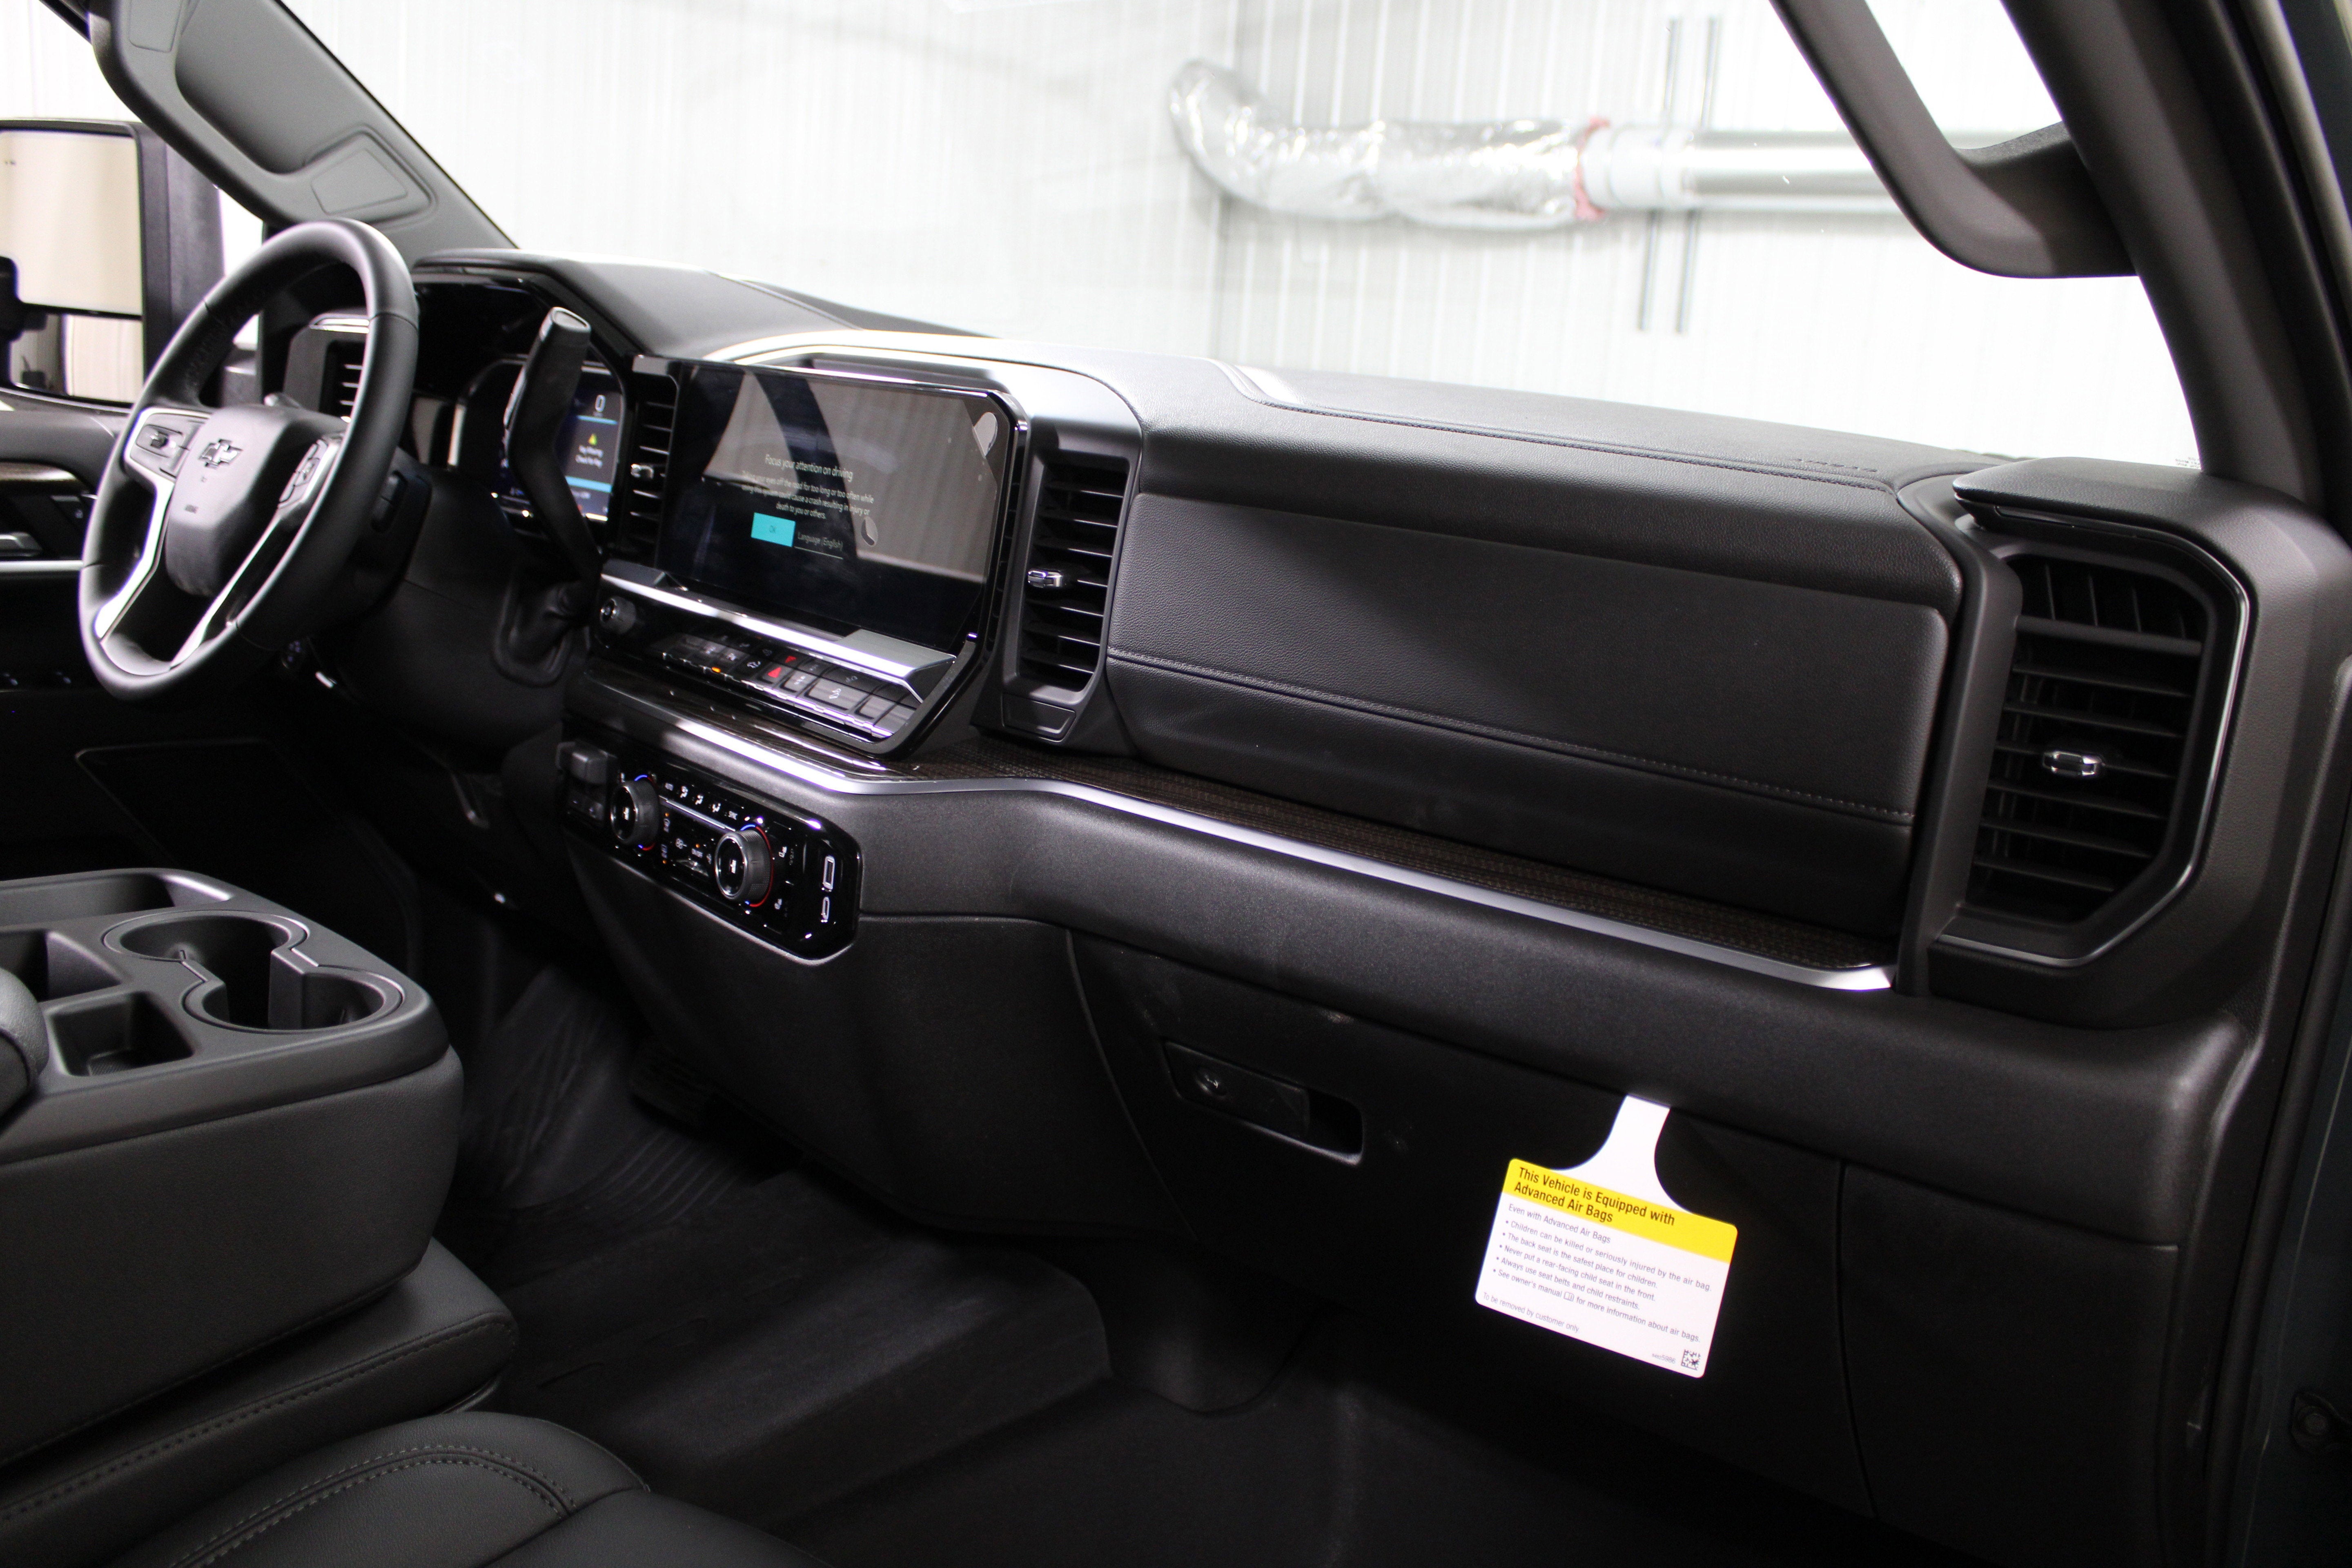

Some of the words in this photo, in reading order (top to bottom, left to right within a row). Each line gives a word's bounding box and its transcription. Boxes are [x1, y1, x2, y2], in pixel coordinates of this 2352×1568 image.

[765, 454, 781, 466] Focus
[782, 460, 795, 469] your
[796, 462, 822, 472] attention
[832, 466, 852, 482] driving
[798, 532, 820, 545] Language
[1514, 1181, 1565, 1206] Advanced
[1567, 1198, 1583, 1212] Air
[1586, 1204, 1613, 1222] Bags
[1519, 1167, 1539, 1183] This
[1543, 1174, 1579, 1196] Vehicle
[1583, 1187, 1592, 1200] is
[1595, 1192, 1647, 1216] Equipped
[1650, 1211, 1675, 1225] with
[1508, 1203, 1525, 1214] Even
[1527, 1211, 1541, 1220] with
[1543, 1215, 1579, 1233] Advanced
[1579, 1227, 1590, 1236] Air
[1592, 1231, 1610, 1243] Bags
[1504, 1245, 1523, 1256] Never
[1523, 1253, 1535, 1261] put
[1542, 1259, 1579, 1277] rear-facing
[1580, 1272, 1597, 1282] child
[1598, 1278, 1613, 1287] seat
[1624, 1285, 1635, 1294] the
[1637, 1289, 1655, 1301] front.
[1508, 1232, 1519, 1242] The
[1520, 1237, 1535, 1247] back
[1537, 1244, 1551, 1253] seat
[1561, 1251, 1571, 1260] the
[1573, 1256, 1594, 1267] safest
[1595, 1263, 1614, 1274] place
[1616, 1269, 1626, 1277] for
[1627, 1274, 1657, 1288] children.
[1511, 1221, 1538, 1235] Children
[1540, 1232, 1552, 1240] can
[1554, 1235, 1562, 1243] be
[1564, 1238, 1584, 1250] killed
[1595, 1250, 1627, 1265] seriously
[1630, 1260, 1655, 1274] injured
[1657, 1268, 1666, 1278] by
[1669, 1272, 1680, 1281] the
[1695, 1280, 1713, 1292] bag.
[1498, 1269, 1509, 1278] See
[1511, 1275, 1536, 1288] owner's
[1538, 1284, 1562, 1297] manual
[1576, 1296, 1585, 1304] for
[1587, 1301, 1604, 1312] more
[1606, 1306, 1646, 1325] information
[1648, 1321, 1668, 1332] about
[1681, 1330, 1702, 1342] bags.
[1501, 1257, 1523, 1270] Always
[1525, 1267, 1537, 1275] use
[1538, 1271, 1552, 1281] seat
[1554, 1275, 1570, 1286] belts
[1572, 1283, 1585, 1291] and
[1586, 1287, 1604, 1297] child
[1605, 1294, 1639, 1310] restraints.
[1499, 1300, 1525, 1313] removed
[1526, 1308, 1534, 1317] by
[1535, 1312, 1564, 1326] customer
